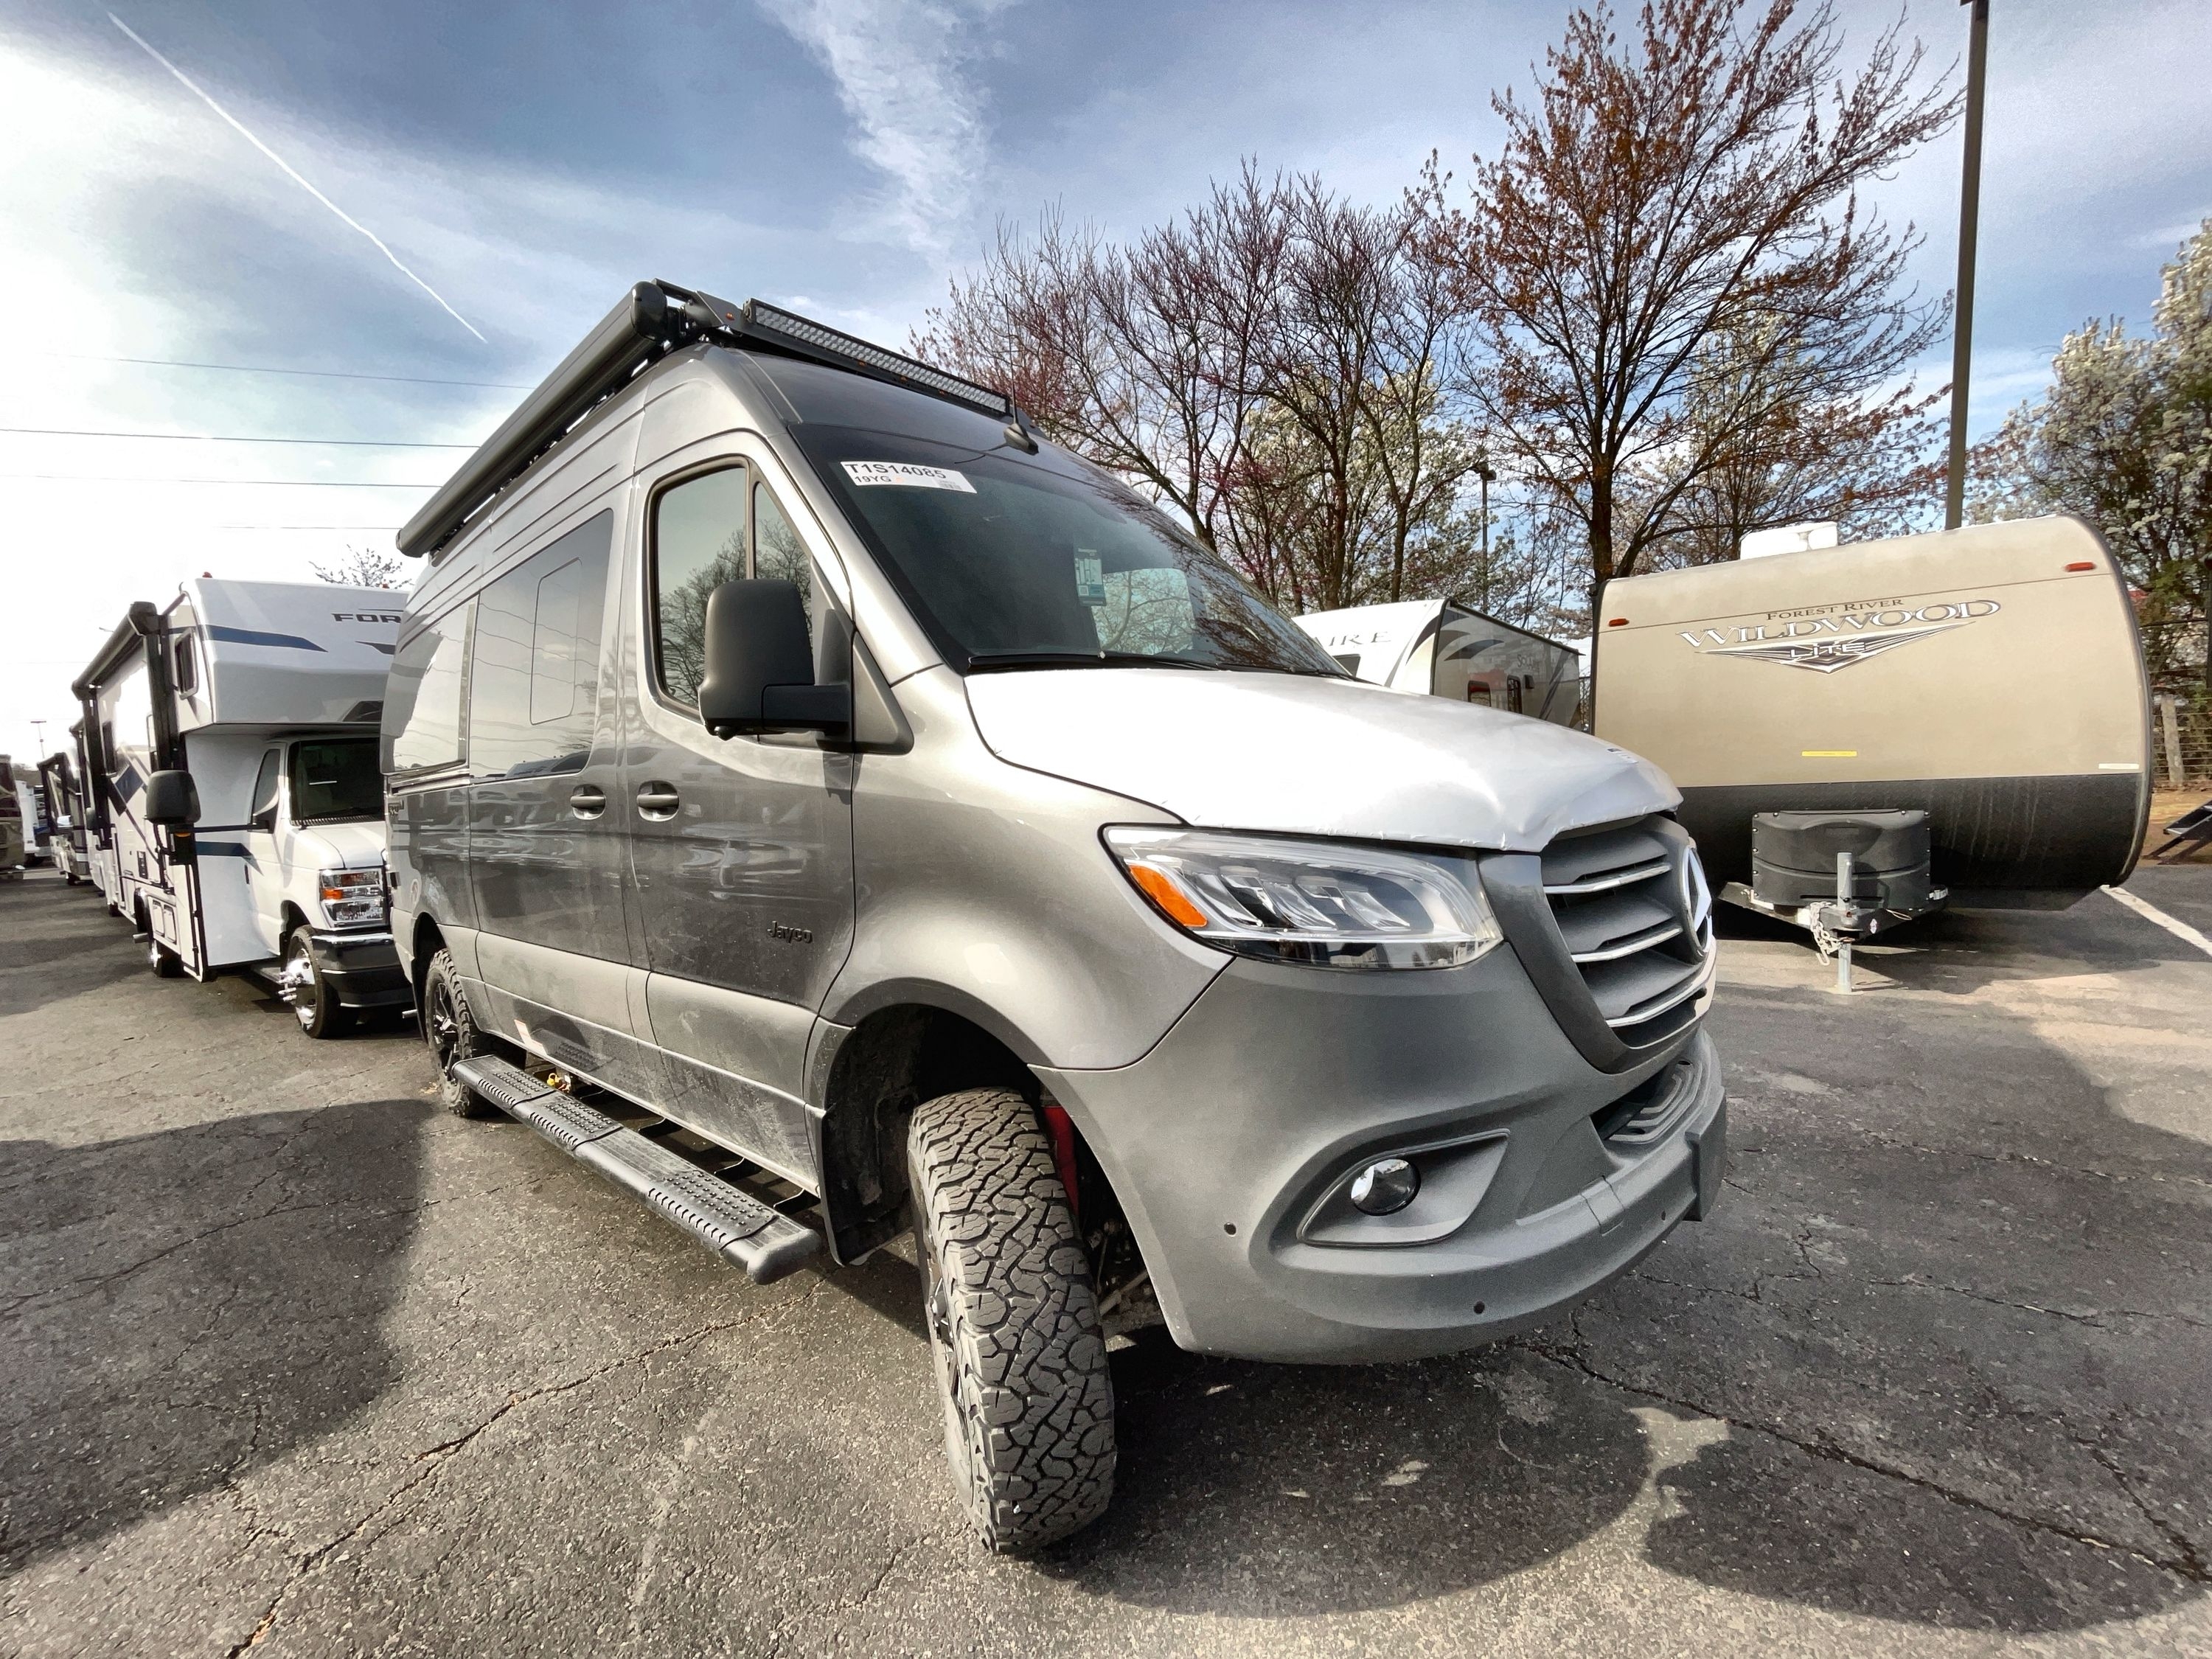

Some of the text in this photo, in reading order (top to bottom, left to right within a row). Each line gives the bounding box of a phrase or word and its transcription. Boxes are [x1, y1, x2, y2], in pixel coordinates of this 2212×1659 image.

[844, 463, 947, 479] T1S14085
[855, 476, 892, 484] 19YG
[331, 613, 402, 624] FOR
[1767, 599, 1905, 621] FOREST RIVER
[1675, 599, 2002, 648] WILDWOOD
[1790, 641, 1865, 658] LITE
[766, 920, 813, 945] Jayco
